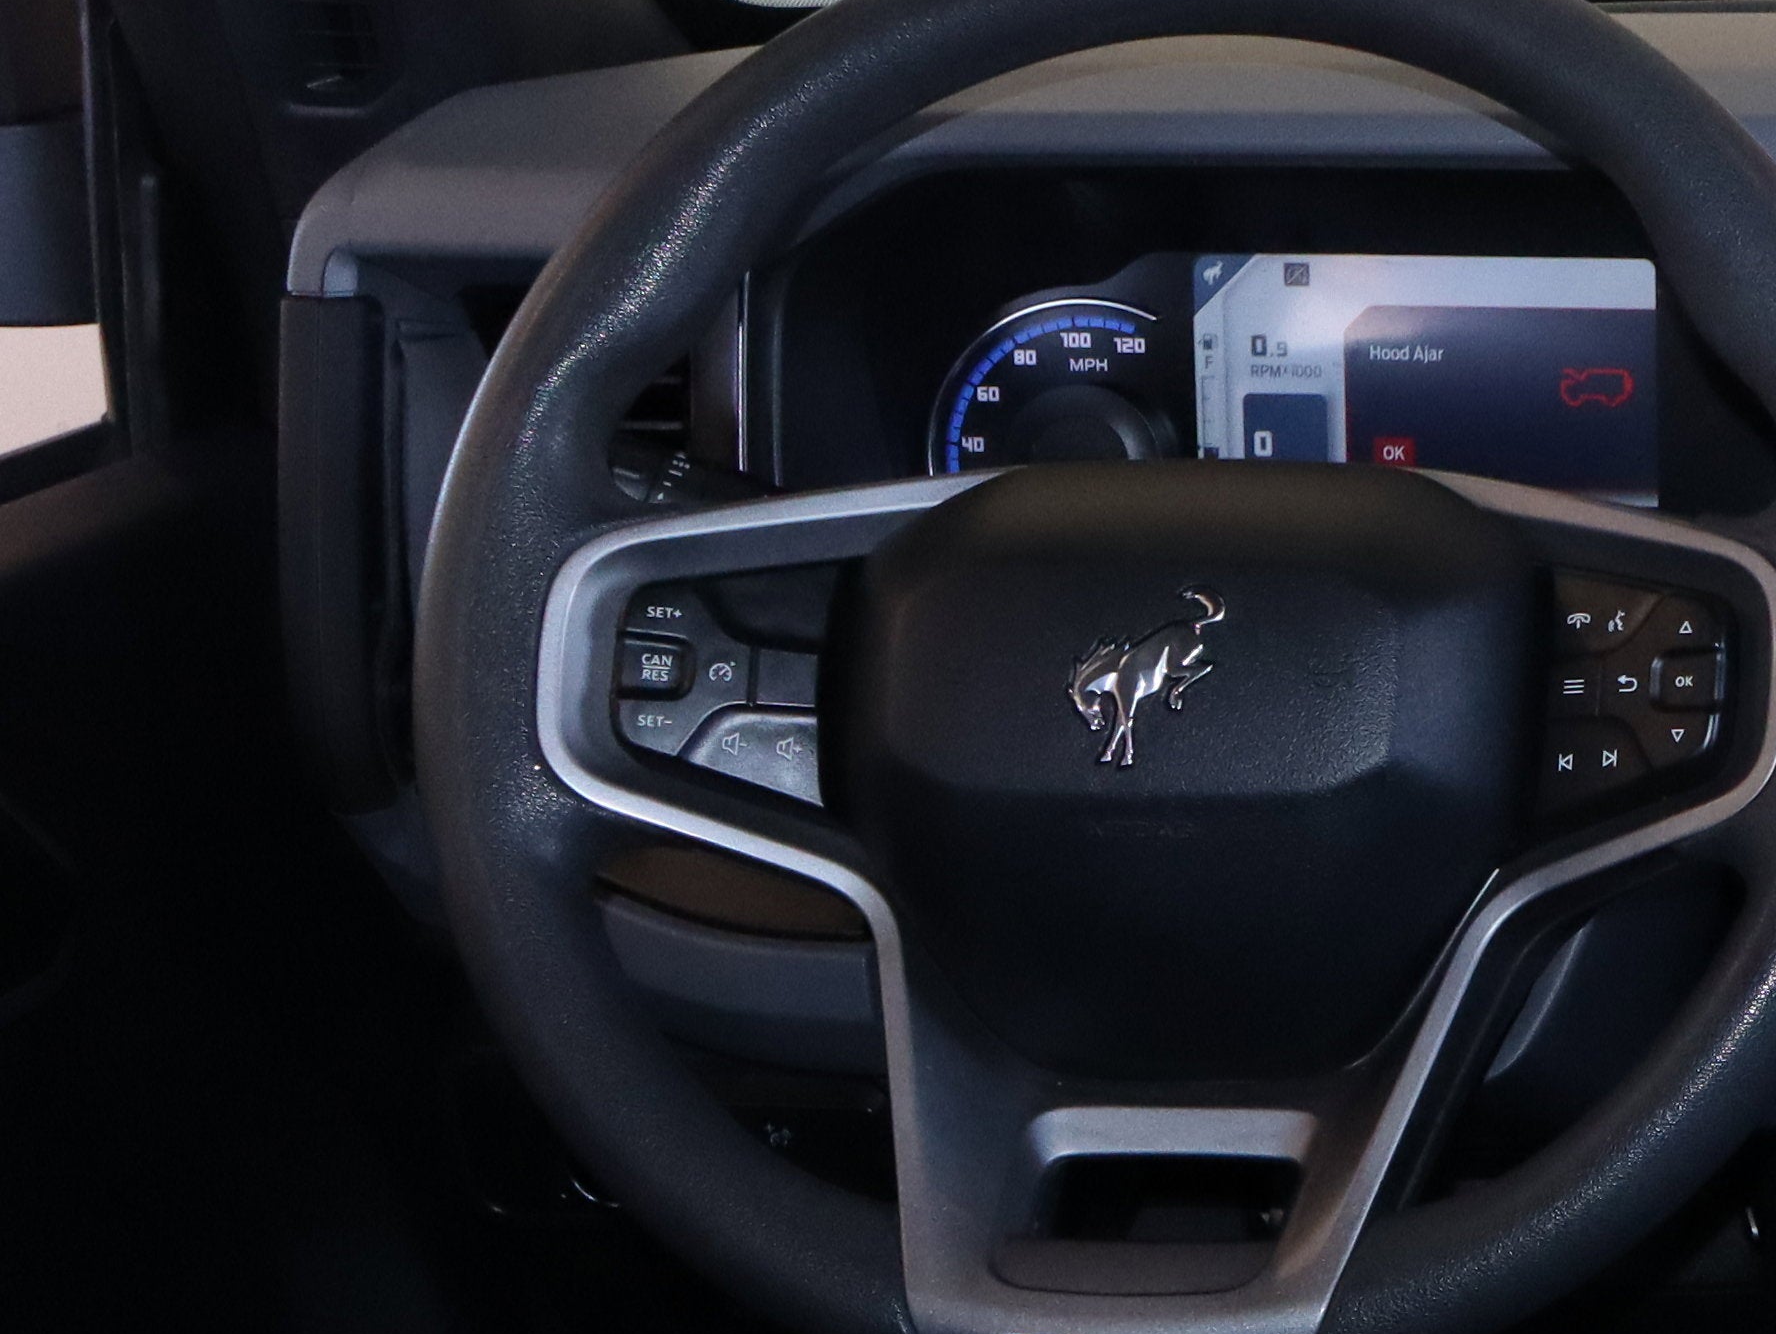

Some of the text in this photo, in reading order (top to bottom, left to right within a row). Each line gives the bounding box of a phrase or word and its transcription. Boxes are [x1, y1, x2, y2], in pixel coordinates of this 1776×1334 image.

[1060, 332, 1091, 348] 100
[1114, 337, 1146, 354] 120
[1013, 349, 1037, 365] 80
[1370, 344, 1444, 364] Hood Ajar
[1069, 358, 1108, 372] MPH
[1205, 356, 1214, 369] F
[977, 386, 1000, 402] 60
[962, 436, 985, 453] 40
[1254, 430, 1273, 457] 0
[1382, 445, 1405, 462] OK
[646, 606, 682, 620] SET+
[641, 653, 673, 666] CAN
[642, 669, 669, 682] RES
[1675, 675, 1693, 687] OK
